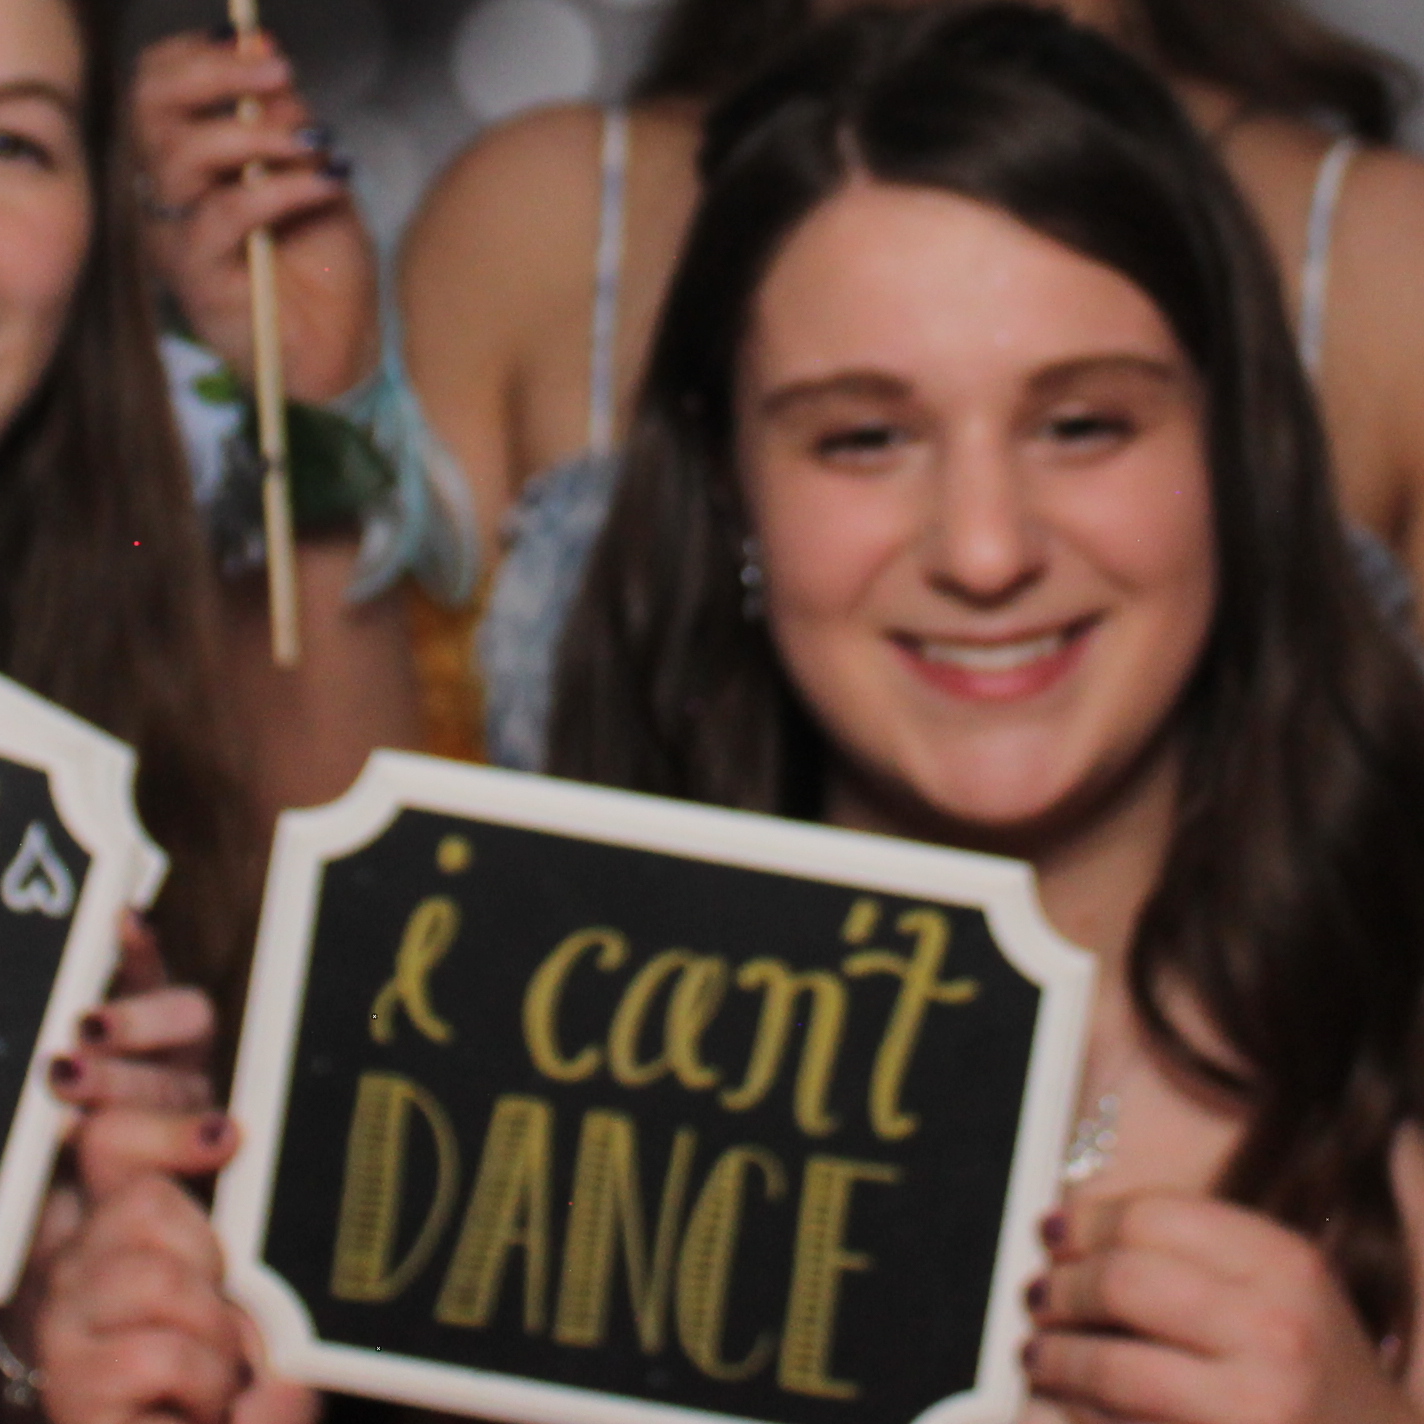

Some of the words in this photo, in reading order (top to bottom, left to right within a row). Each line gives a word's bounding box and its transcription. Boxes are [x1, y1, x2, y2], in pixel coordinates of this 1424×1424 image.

[370, 833, 474, 1044] i
[522, 898, 980, 1143] can't
[329, 1070, 904, 1401] DANCE
